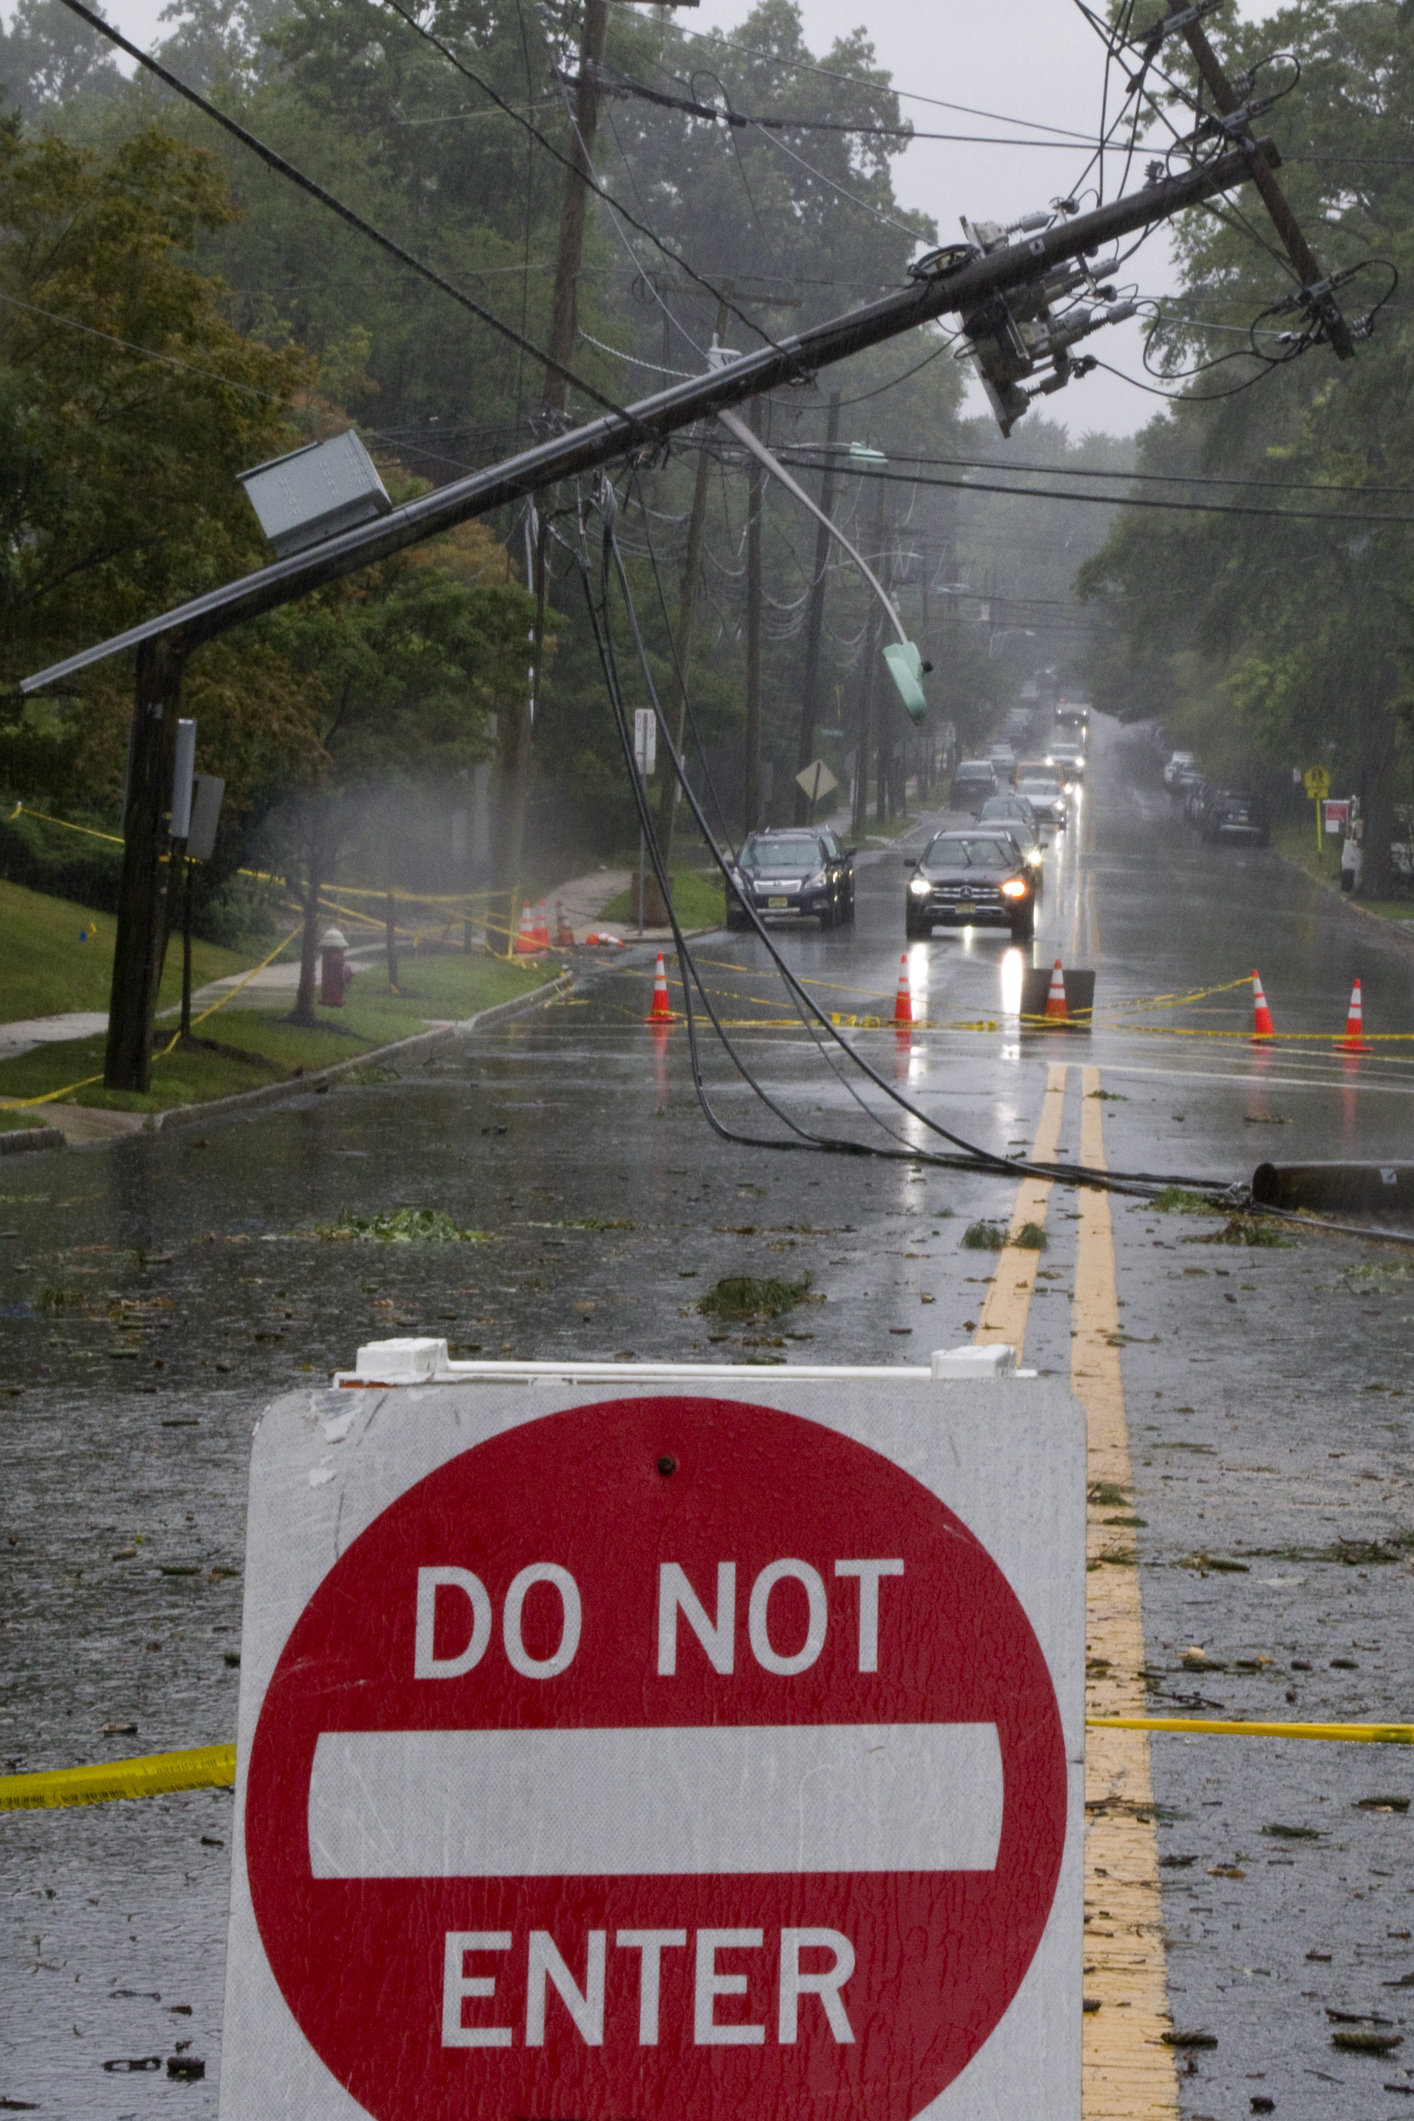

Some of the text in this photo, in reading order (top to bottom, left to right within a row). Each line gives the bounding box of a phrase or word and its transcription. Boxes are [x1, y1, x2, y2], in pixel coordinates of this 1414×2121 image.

[414, 1558, 904, 1679] DO NOT
[441, 1927, 856, 2047] ENTER
